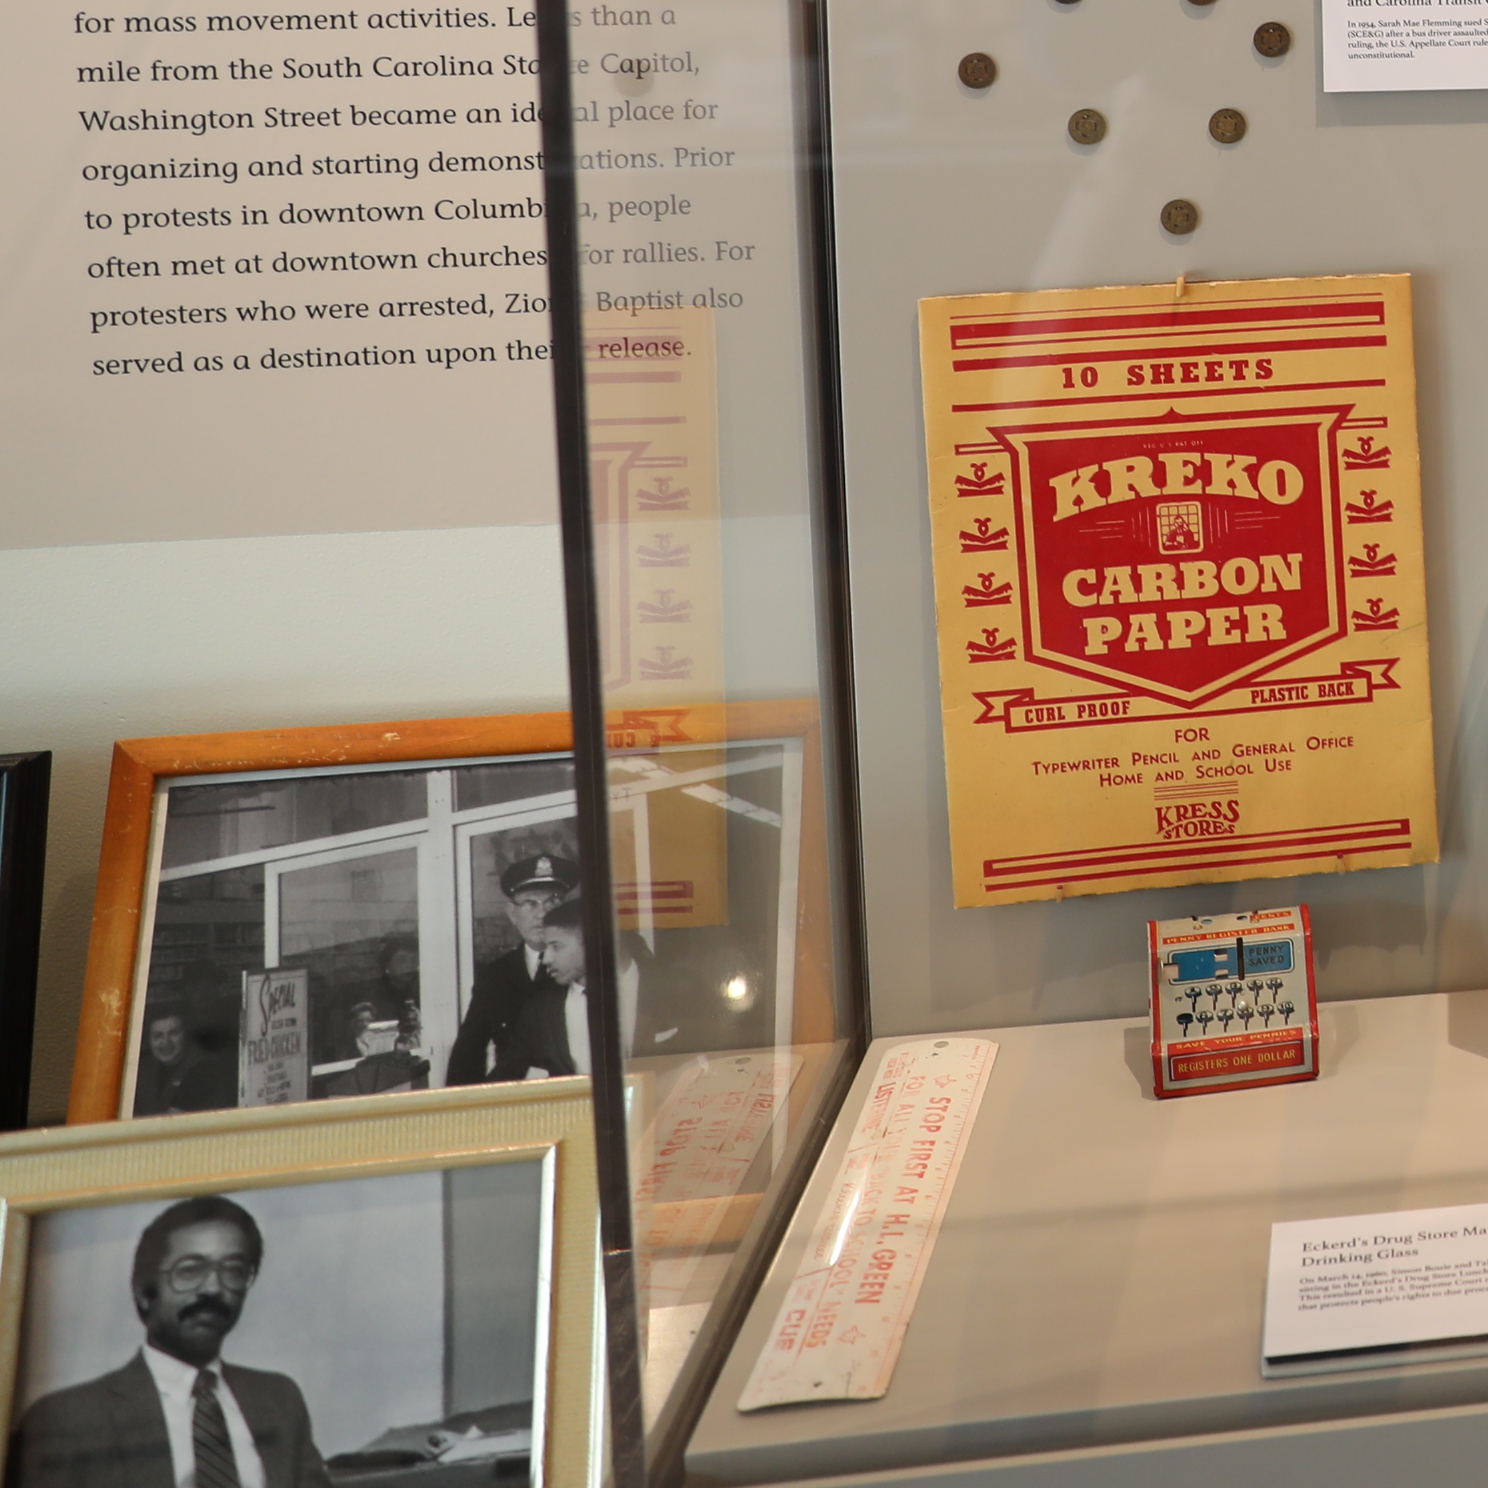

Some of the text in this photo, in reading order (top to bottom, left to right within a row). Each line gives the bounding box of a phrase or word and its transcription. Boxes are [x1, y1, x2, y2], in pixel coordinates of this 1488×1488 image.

[74, 7, 497, 35] for mass movement activities.
[1062, 358, 1274, 389] 10 SHEETS
[1048, 450, 1304, 523] KREKO
[1062, 553, 1303, 608] CARBON
[1083, 603, 1287, 656] PAPER
[1025, 681, 1355, 724] CURL PROOF PLASTIC BACK
[1174, 727, 1210, 743] FOR
[1032, 735, 1354, 776] TYPEWRITER PENCIL AND GENERAL OFFICE
[1099, 757, 1292, 788] HOME AND SCHOOL USE
[1155, 799, 1240, 835] KRESS
[1178, 1049, 1295, 1074] REGISTERS DOLLAR
[1302, 1234, 1370, 1254] Eckerd's
[1373, 1231, 1413, 1249] Drug
[1417, 1226, 1458, 1242] Store
[1301, 1245, 1420, 1269] Drinking Glass
